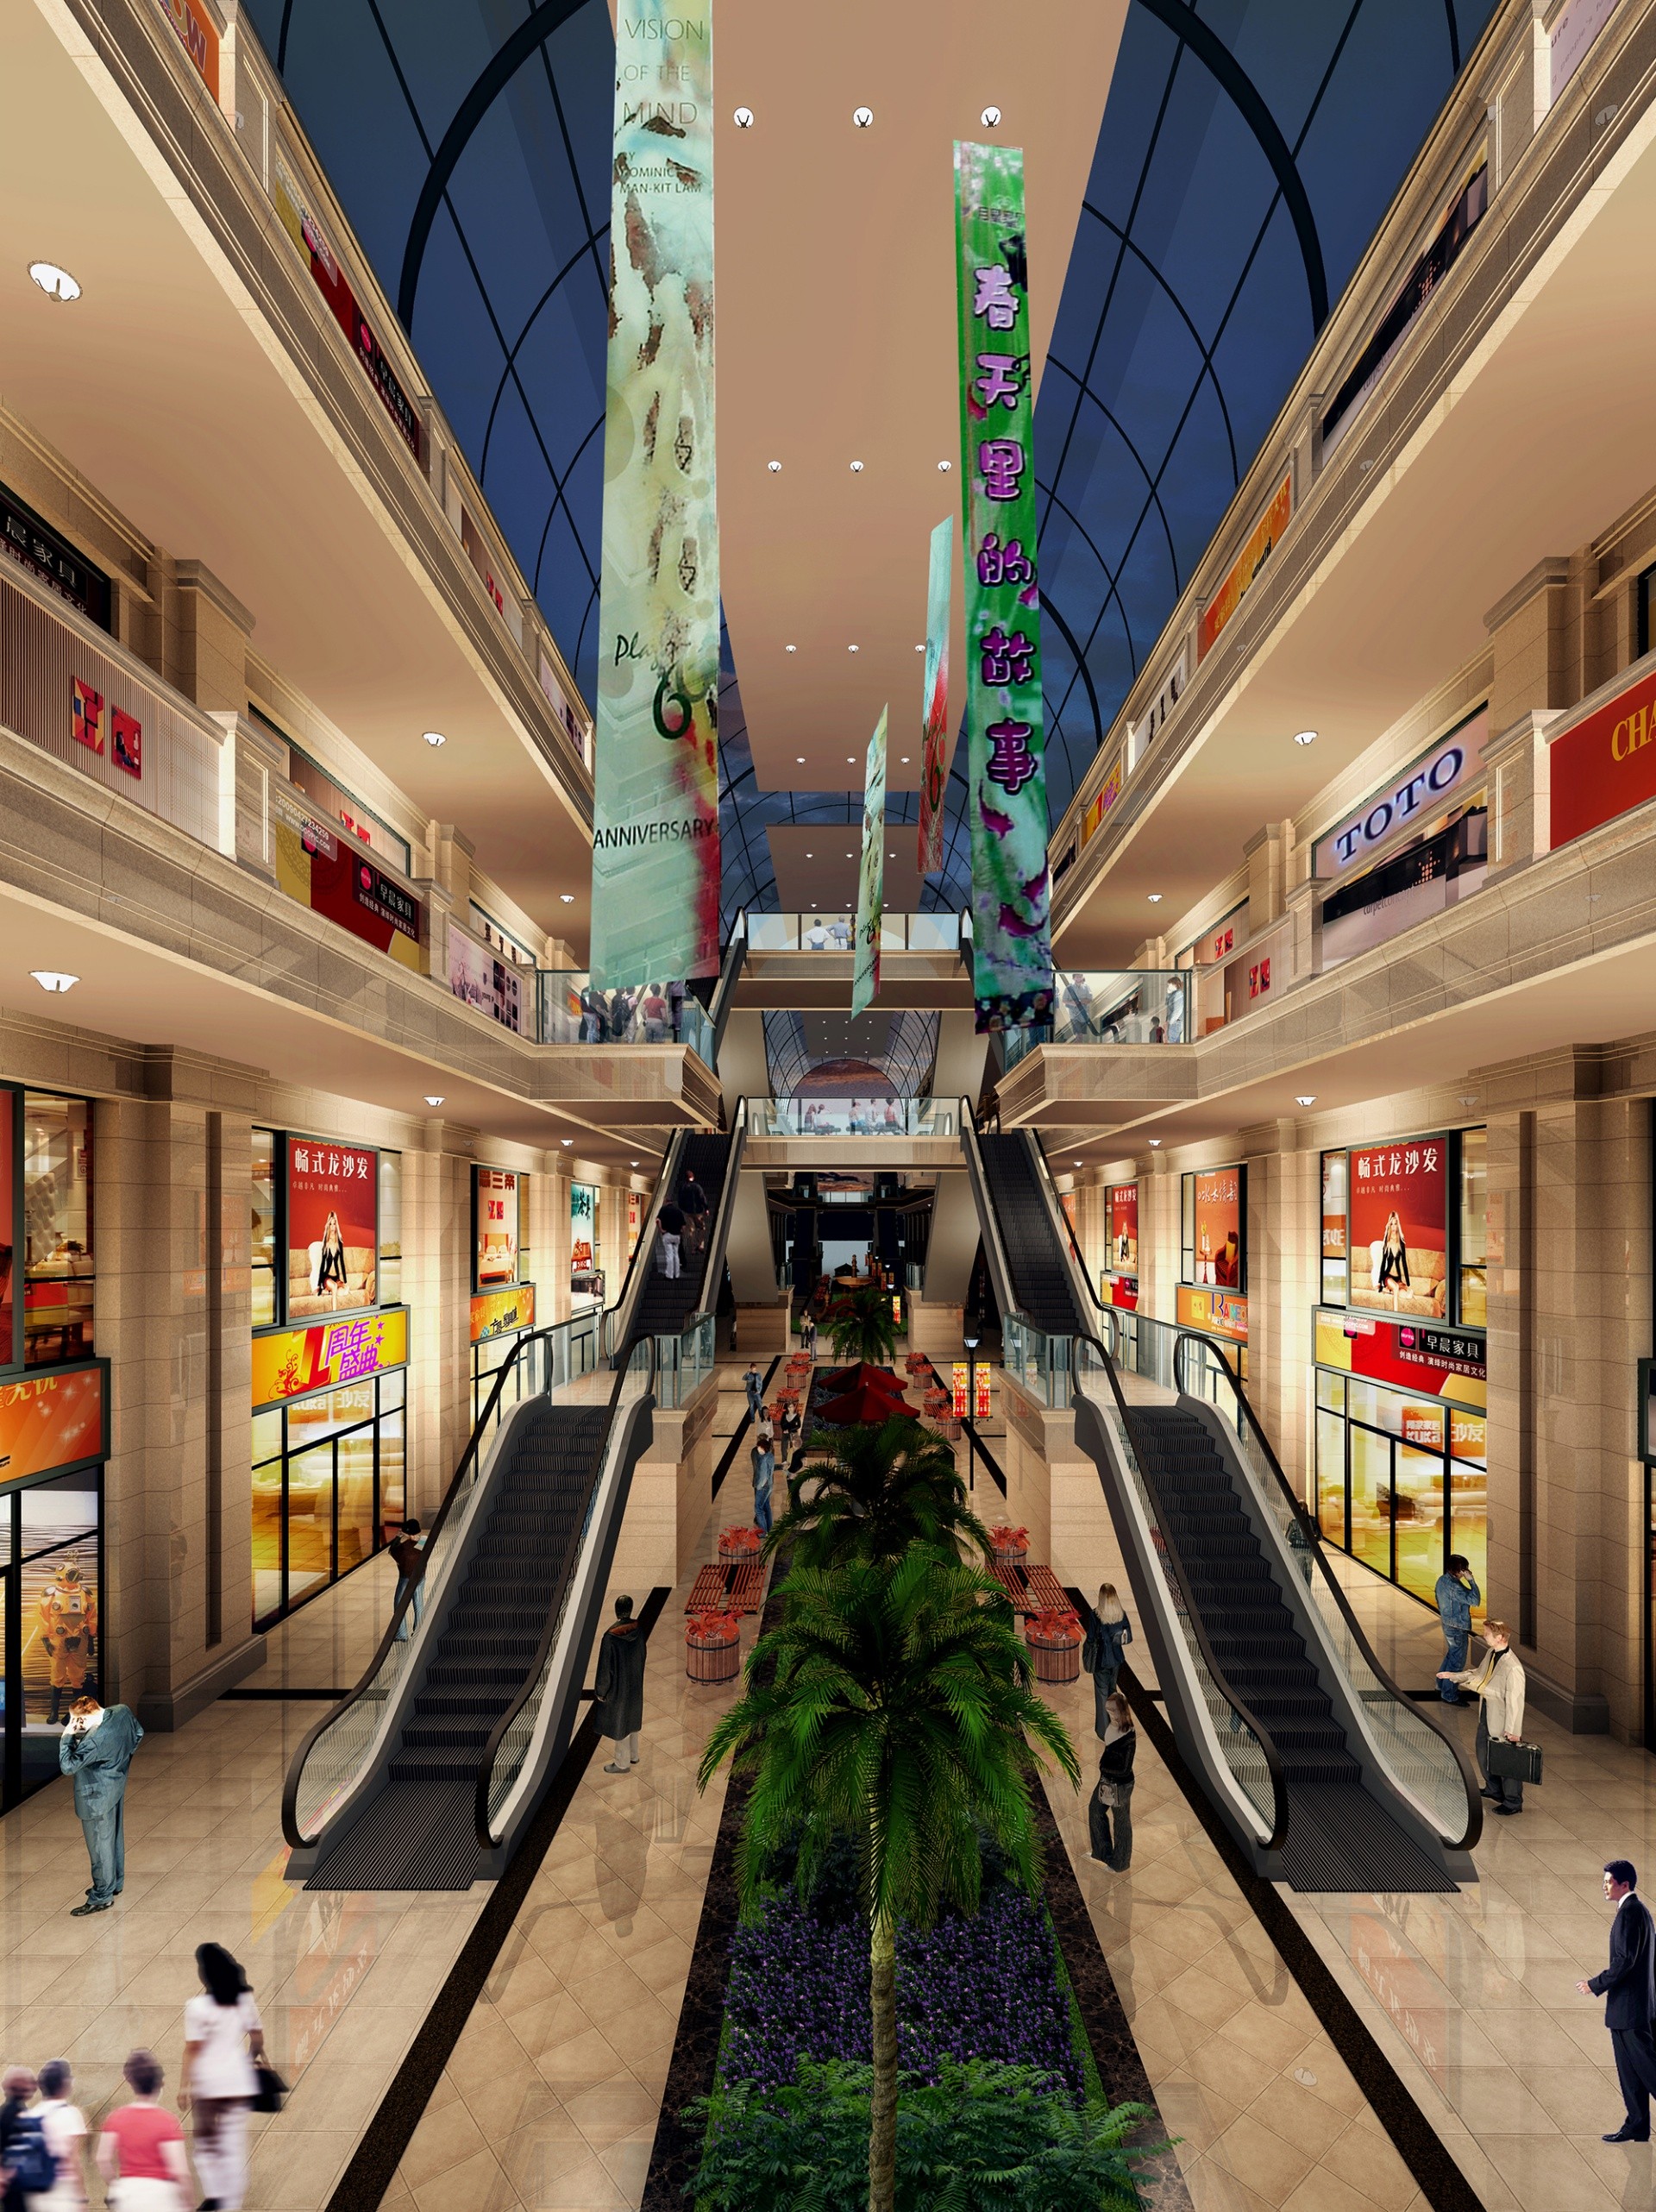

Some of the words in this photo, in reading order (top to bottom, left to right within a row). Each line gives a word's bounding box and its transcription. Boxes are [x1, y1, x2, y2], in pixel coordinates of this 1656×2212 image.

[624, 19, 703, 41] VISION
[624, 65, 648, 81] OF
[656, 65, 690, 82] THE
[624, 102, 698, 125] MIND
[619, 183, 671, 194] MAN-KIT
[675, 183, 702, 194] LAM
[1337, 747, 1465, 862] TOTO
[594, 818, 713, 851] ANNIVERSARY
[294, 1147, 369, 1180] 畅式龙沙发
[1358, 1147, 1440, 1179] 畅式龙沙发
[1427, 1335, 1480, 1359] 早晨家具
